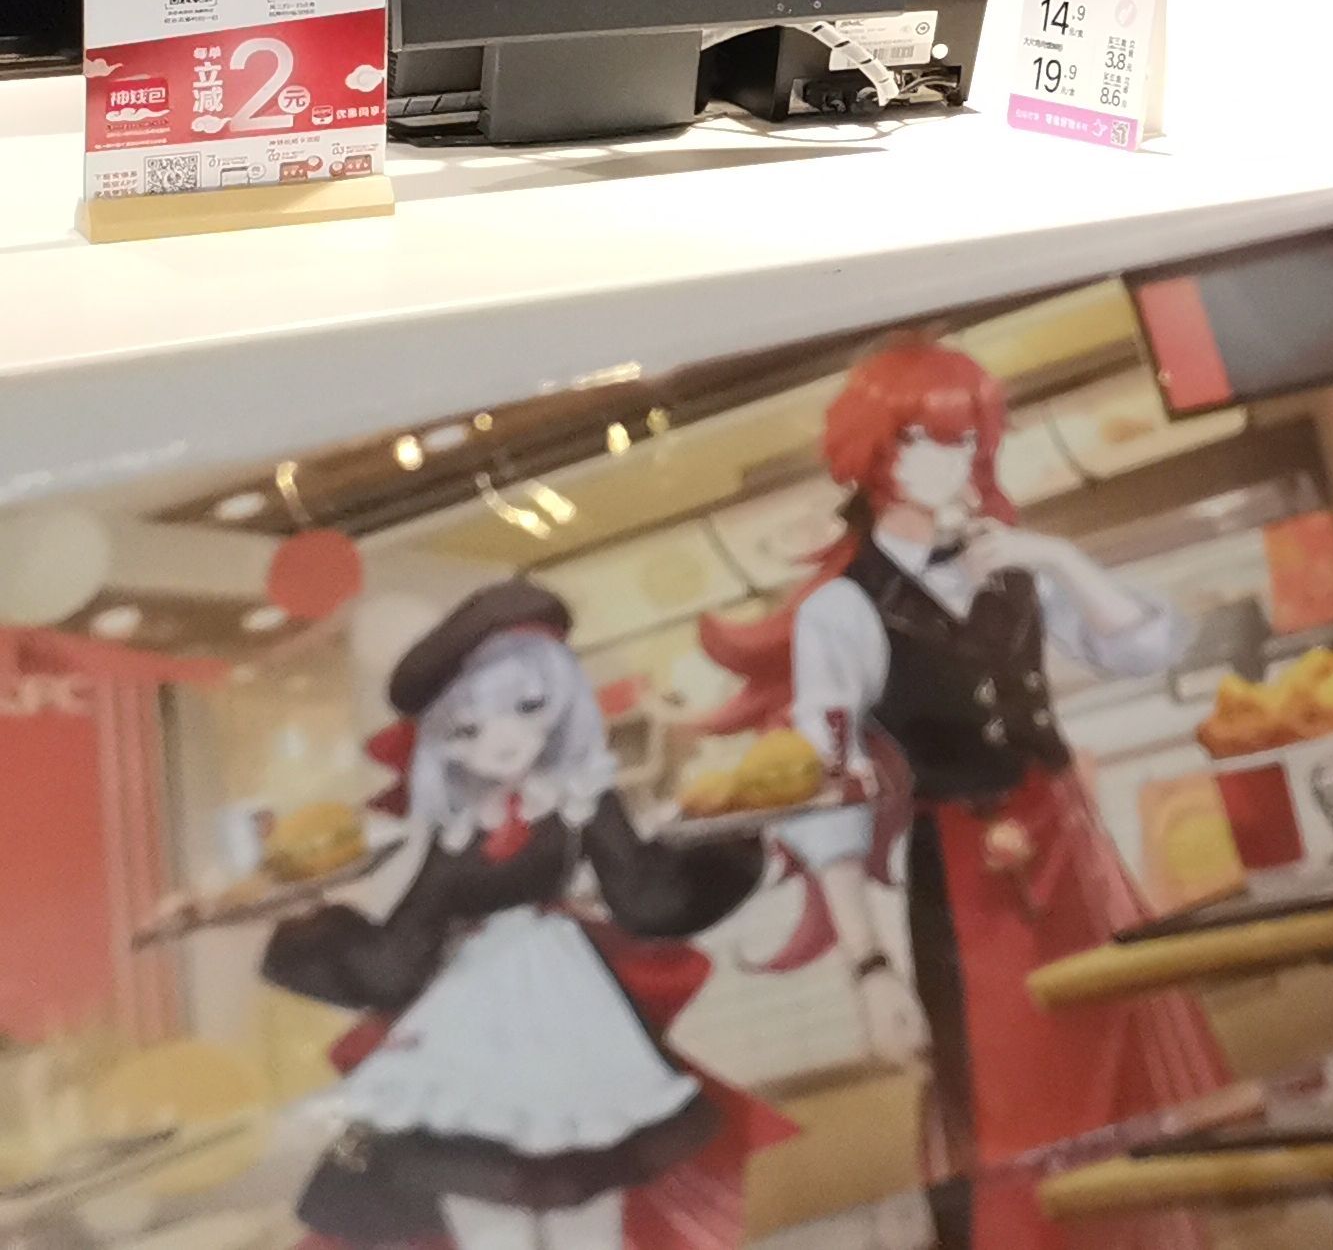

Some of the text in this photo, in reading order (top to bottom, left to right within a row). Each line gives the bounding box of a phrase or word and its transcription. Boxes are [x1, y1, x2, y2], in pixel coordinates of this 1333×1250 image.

[192, 61, 224, 113] 立减
[229, 37, 295, 132] 2
[1033, 56, 1078, 93] 19.9
[283, 88, 306, 109] 元
